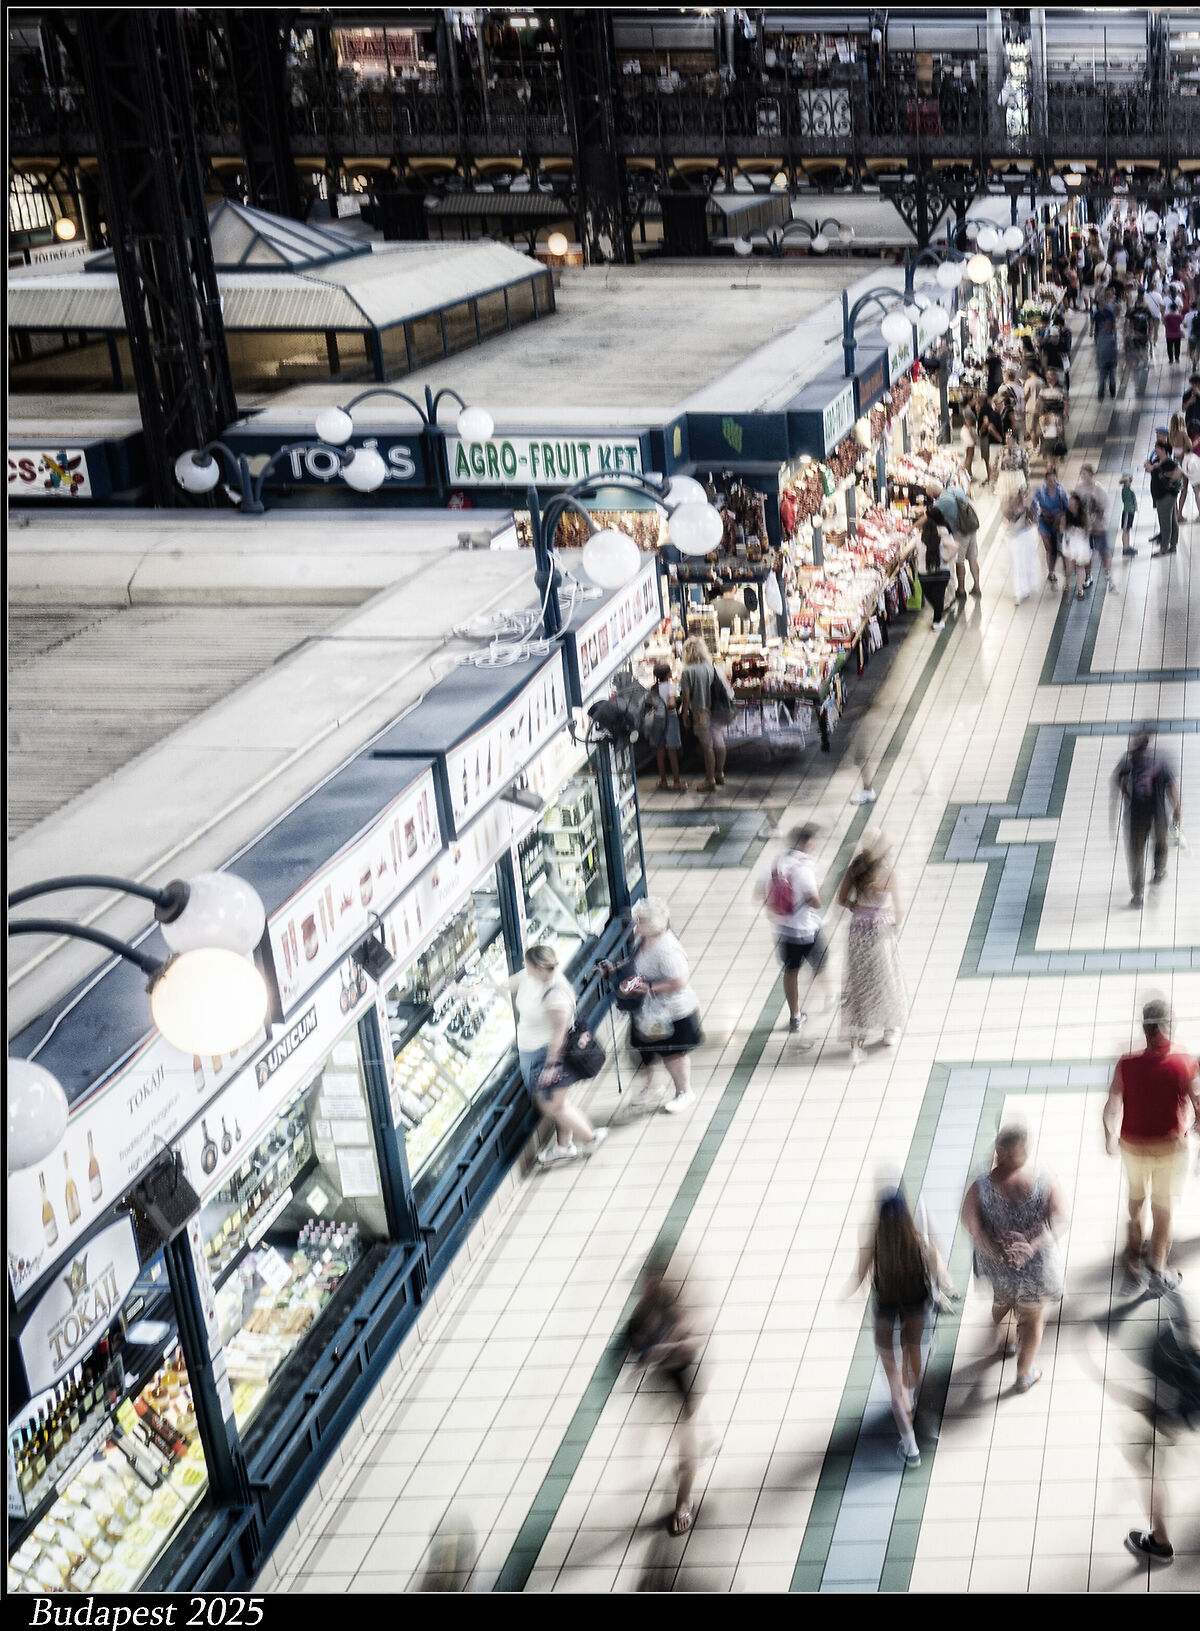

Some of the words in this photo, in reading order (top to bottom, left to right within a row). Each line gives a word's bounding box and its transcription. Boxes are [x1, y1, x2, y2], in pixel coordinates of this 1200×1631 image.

[284, 443, 415, 480] TOS
[455, 440, 591, 478] AGRO-FRUIT
[267, 1010, 317, 1073] UNICUM
[127, 1064, 164, 1114] TOKAJI
[50, 1269, 120, 1363] TOKAJI
